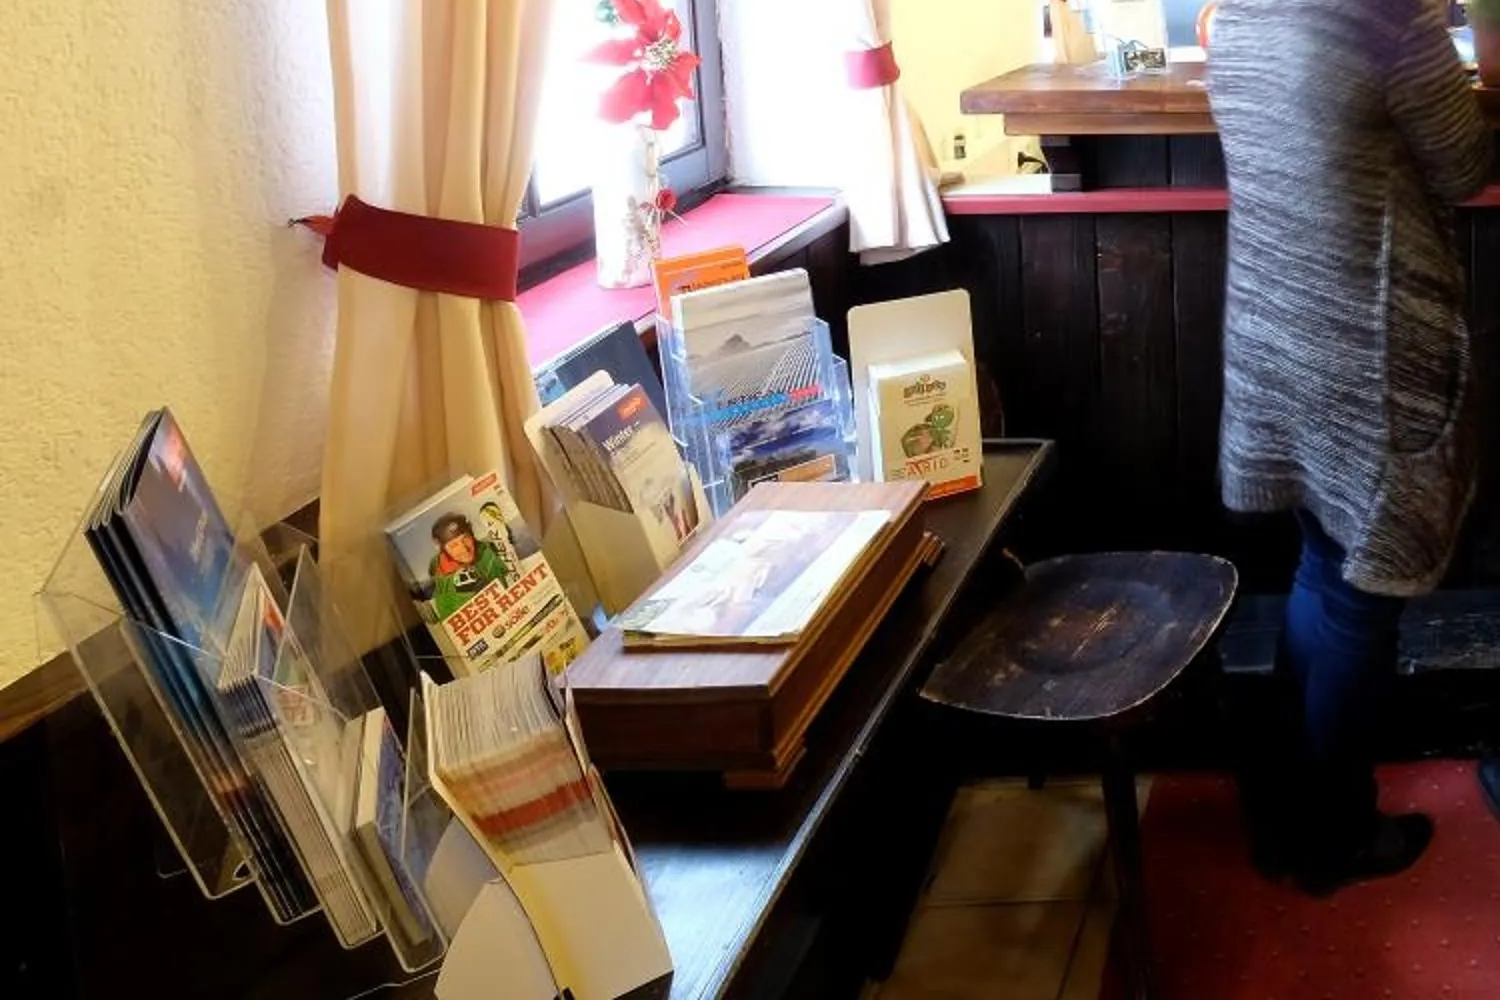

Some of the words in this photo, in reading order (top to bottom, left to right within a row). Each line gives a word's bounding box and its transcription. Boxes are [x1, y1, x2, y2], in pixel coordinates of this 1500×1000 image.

[447, 583, 500, 632] BEST
[455, 608, 500, 647] FOR
[496, 563, 549, 614] RENT
